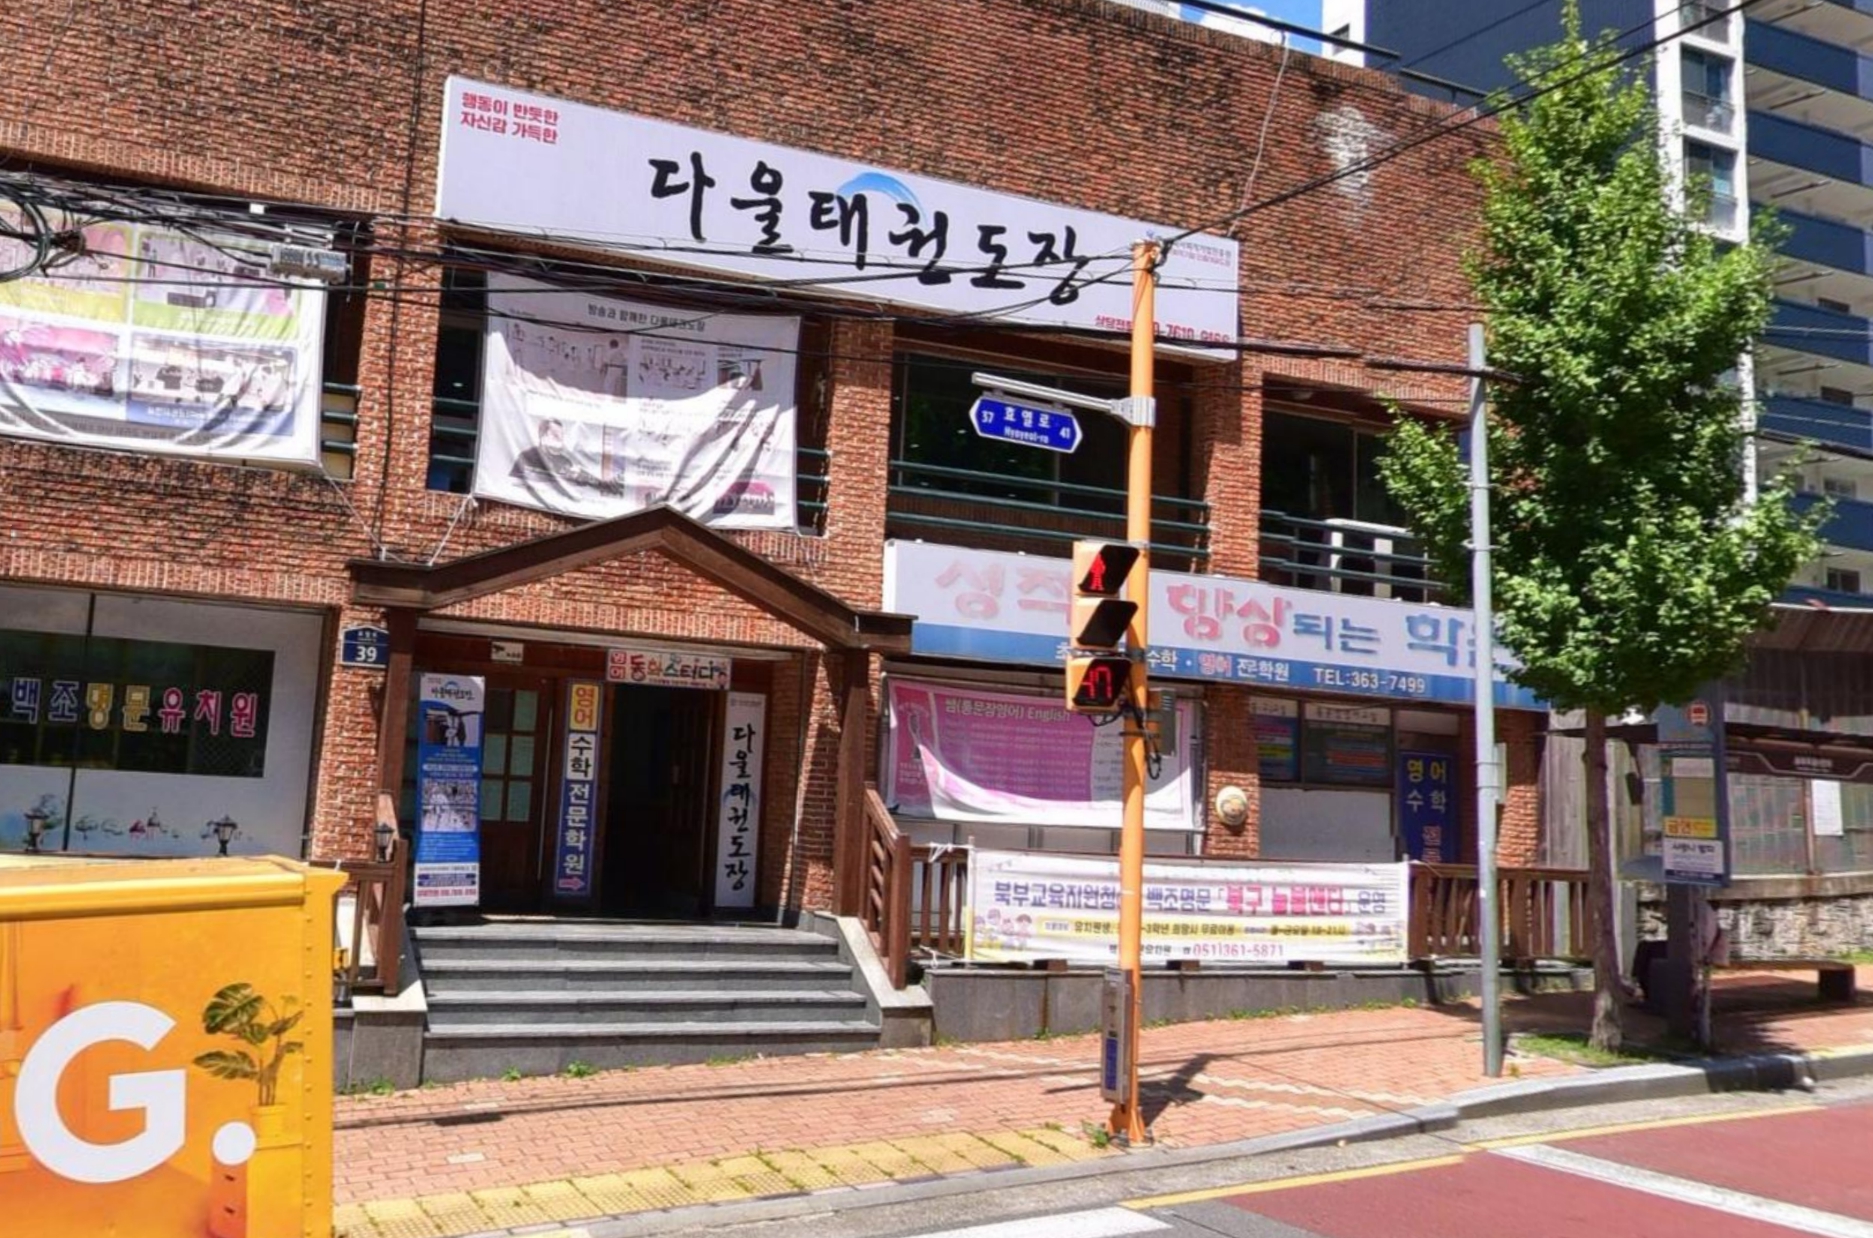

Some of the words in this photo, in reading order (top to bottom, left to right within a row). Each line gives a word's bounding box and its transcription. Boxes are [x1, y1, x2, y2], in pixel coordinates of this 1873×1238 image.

[462, 91, 508, 115] 행동이
[513, 103, 559, 126] 반듯한
[460, 111, 507, 134] 자신감
[511, 122, 558, 145] 가득한
[649, 151, 1089, 305] 다울태권도장
[981, 410, 995, 424] 37
[1004, 406, 1050, 429] 효열로
[1059, 426, 1071, 439] 41
[1166, 583, 1381, 655] 향상되는
[1405, 613, 1490, 668] 학
[356, 645, 377, 662] 39
[1314, 667, 1426, 694] TEL:363-7499
[12, 677, 258, 738] 백조명문유치원
[574, 687, 595, 728] 영어
[571, 736, 592, 778] 수학
[1407, 759, 1447, 783] 영어
[725, 723, 756, 891] 다울태권도장
[1406, 789, 1447, 813] 수학
[563, 783, 590, 876] 전문학원
